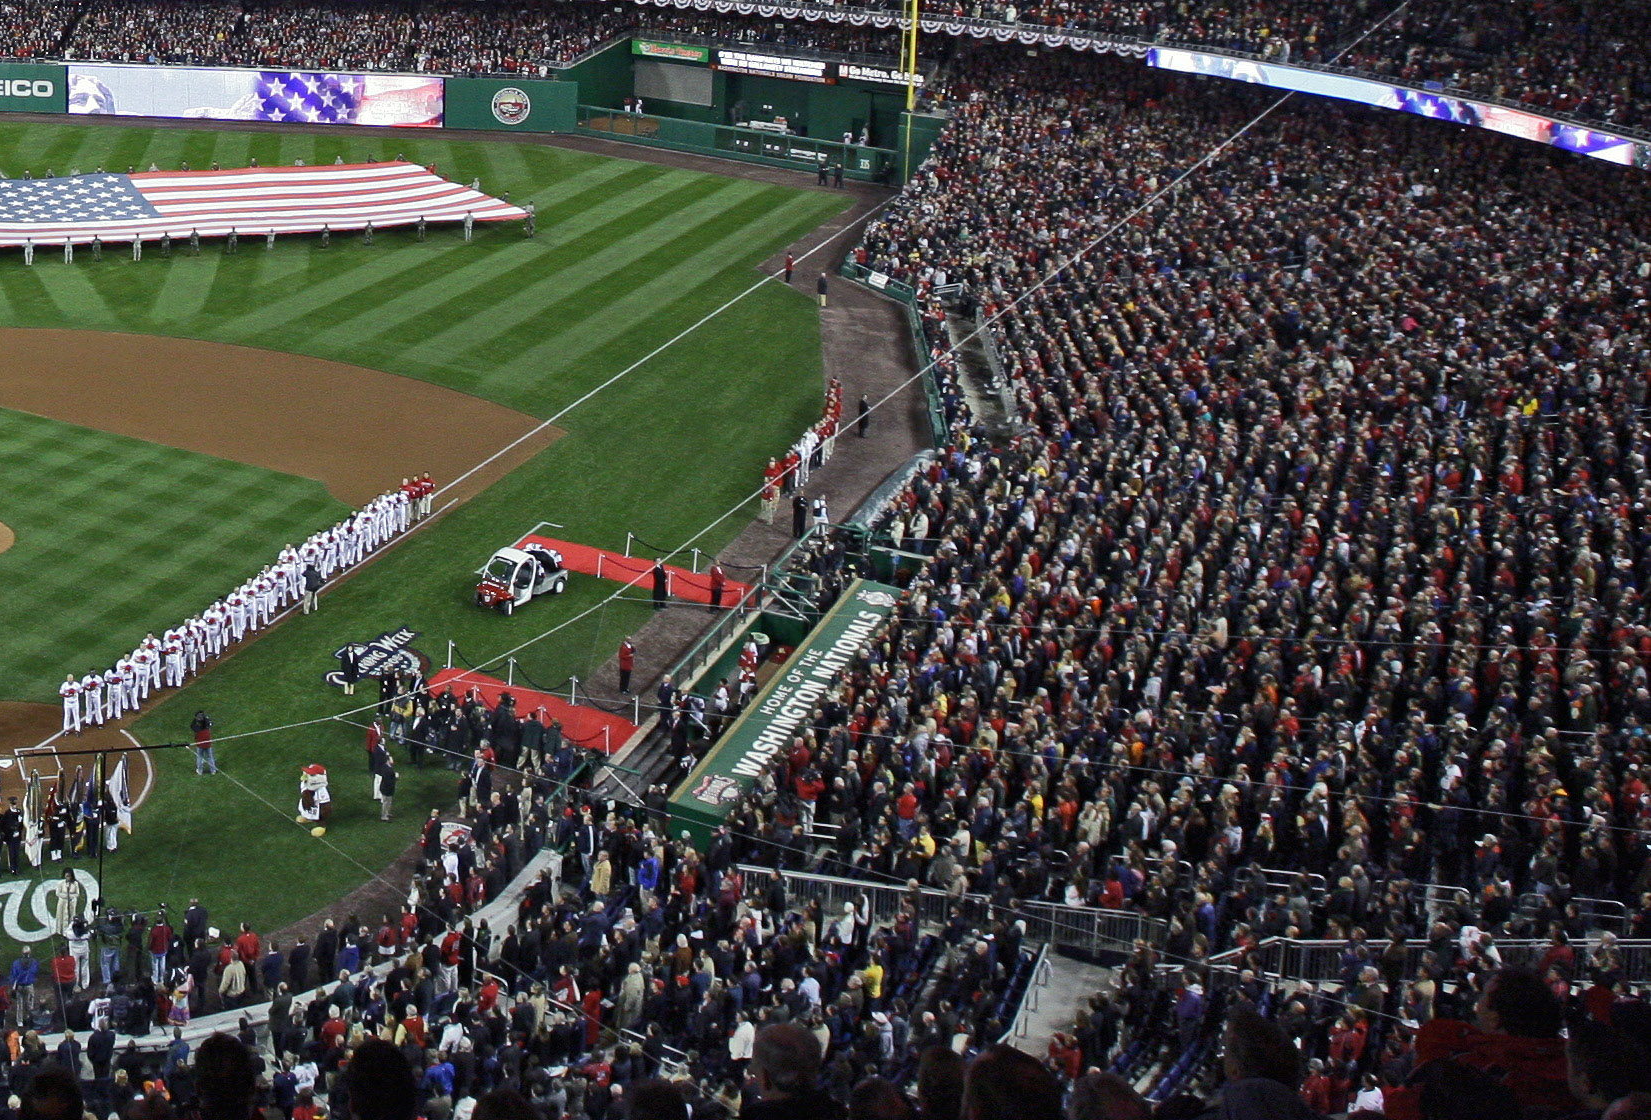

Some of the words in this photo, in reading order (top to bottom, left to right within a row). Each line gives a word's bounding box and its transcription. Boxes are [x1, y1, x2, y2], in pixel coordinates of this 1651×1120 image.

[731, 679, 828, 777] WASHINGTON
[811, 610, 883, 680] NATIONALS
[760, 684, 794, 716] HOME
[786, 668, 805, 683] OF
[798, 648, 824, 668] THE
